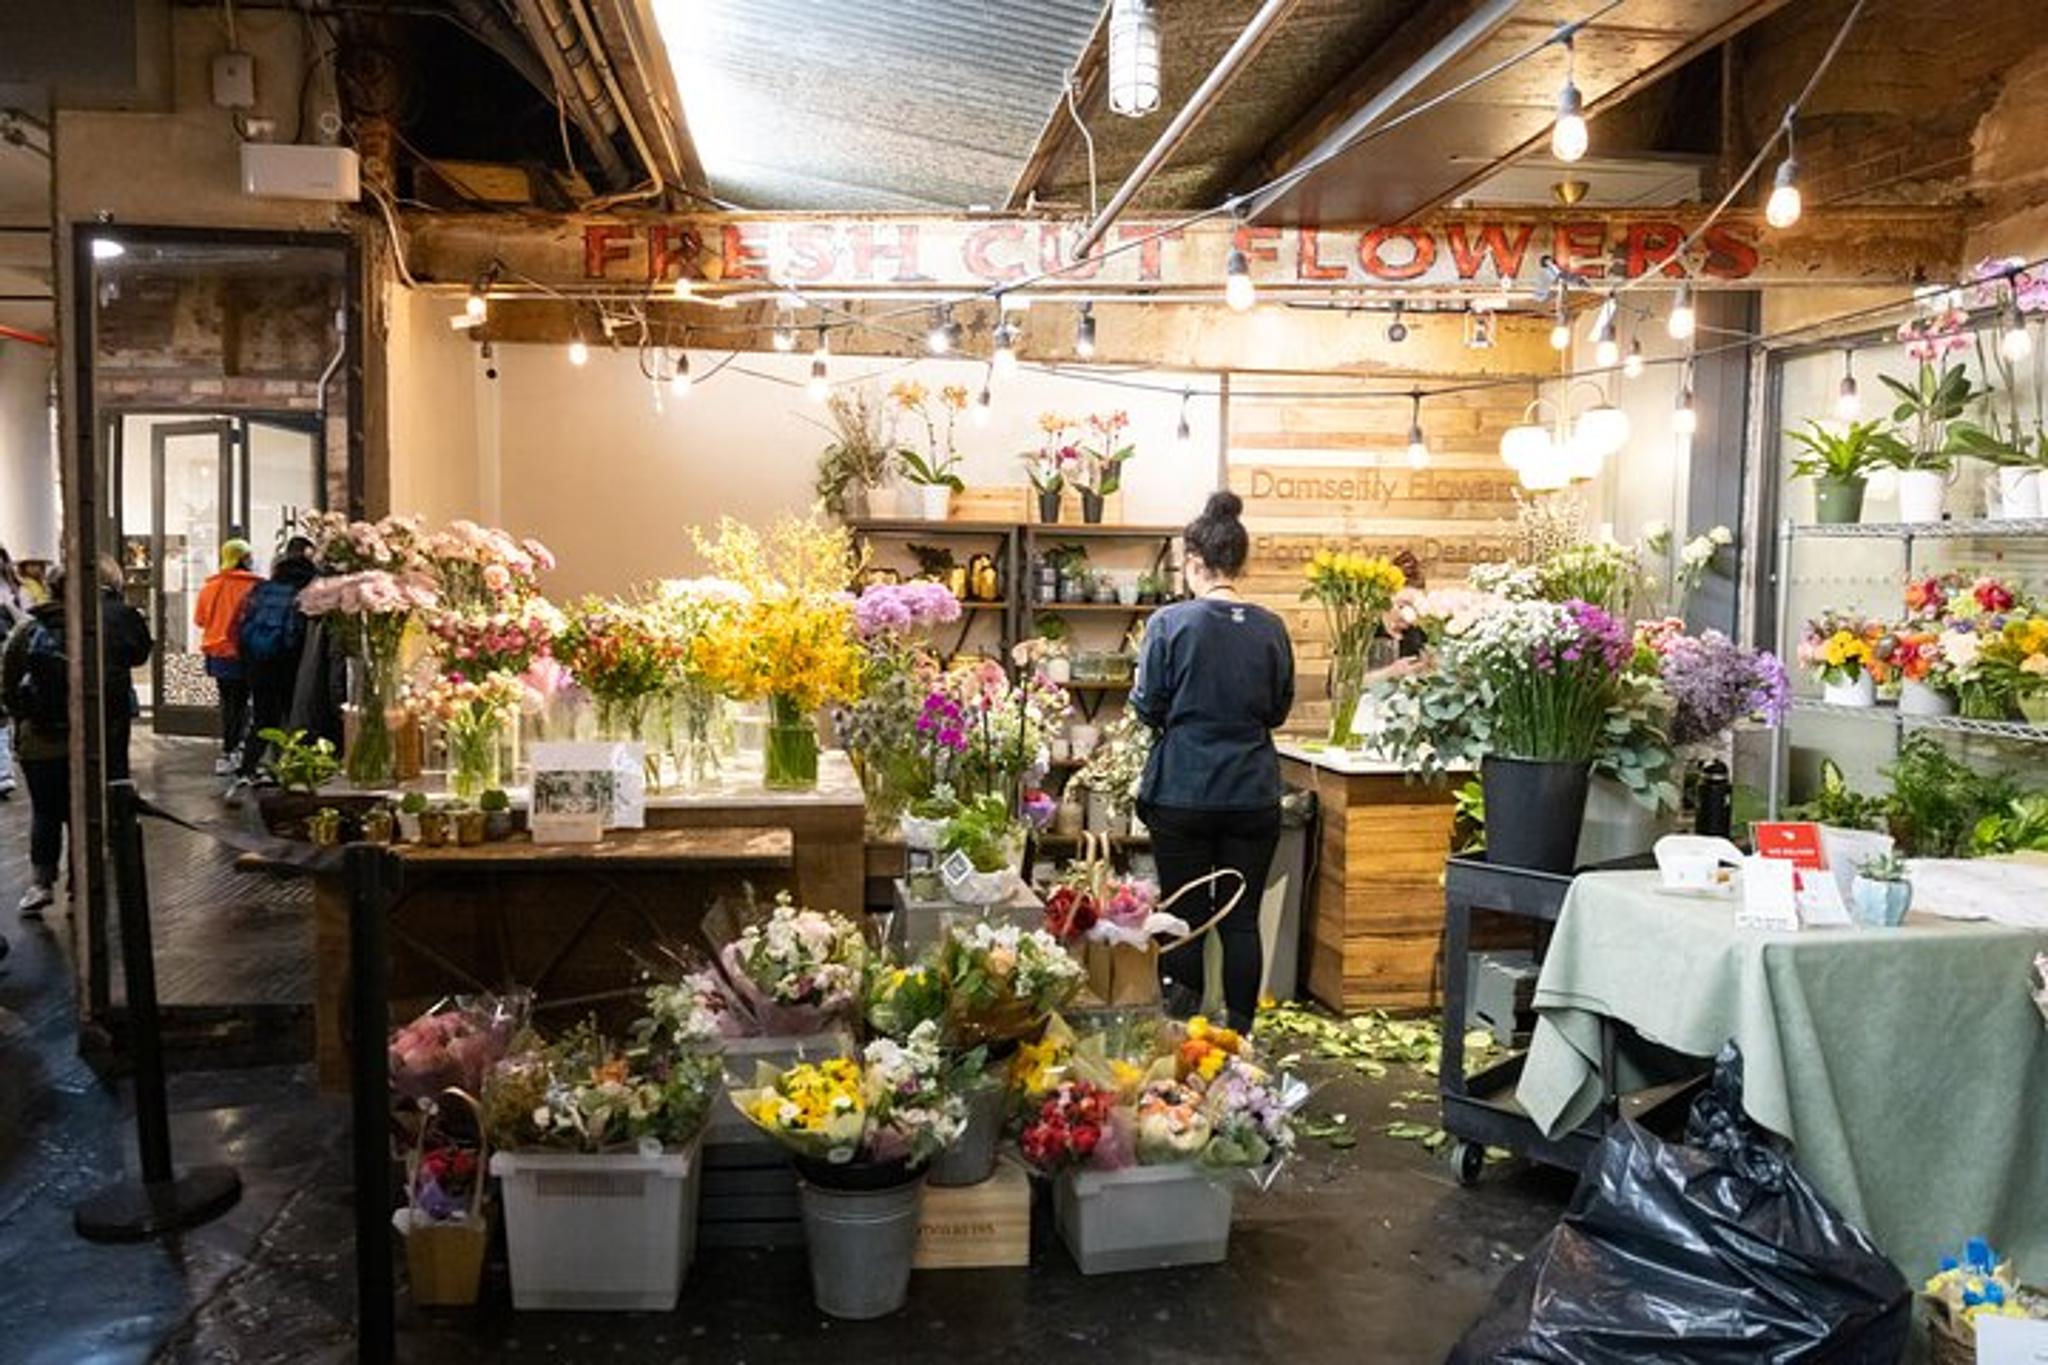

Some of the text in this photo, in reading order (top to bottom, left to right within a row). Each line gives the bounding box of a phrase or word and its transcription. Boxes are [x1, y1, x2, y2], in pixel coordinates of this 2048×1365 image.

[583, 222, 1761, 282] FRESH CUT FLOWERS
